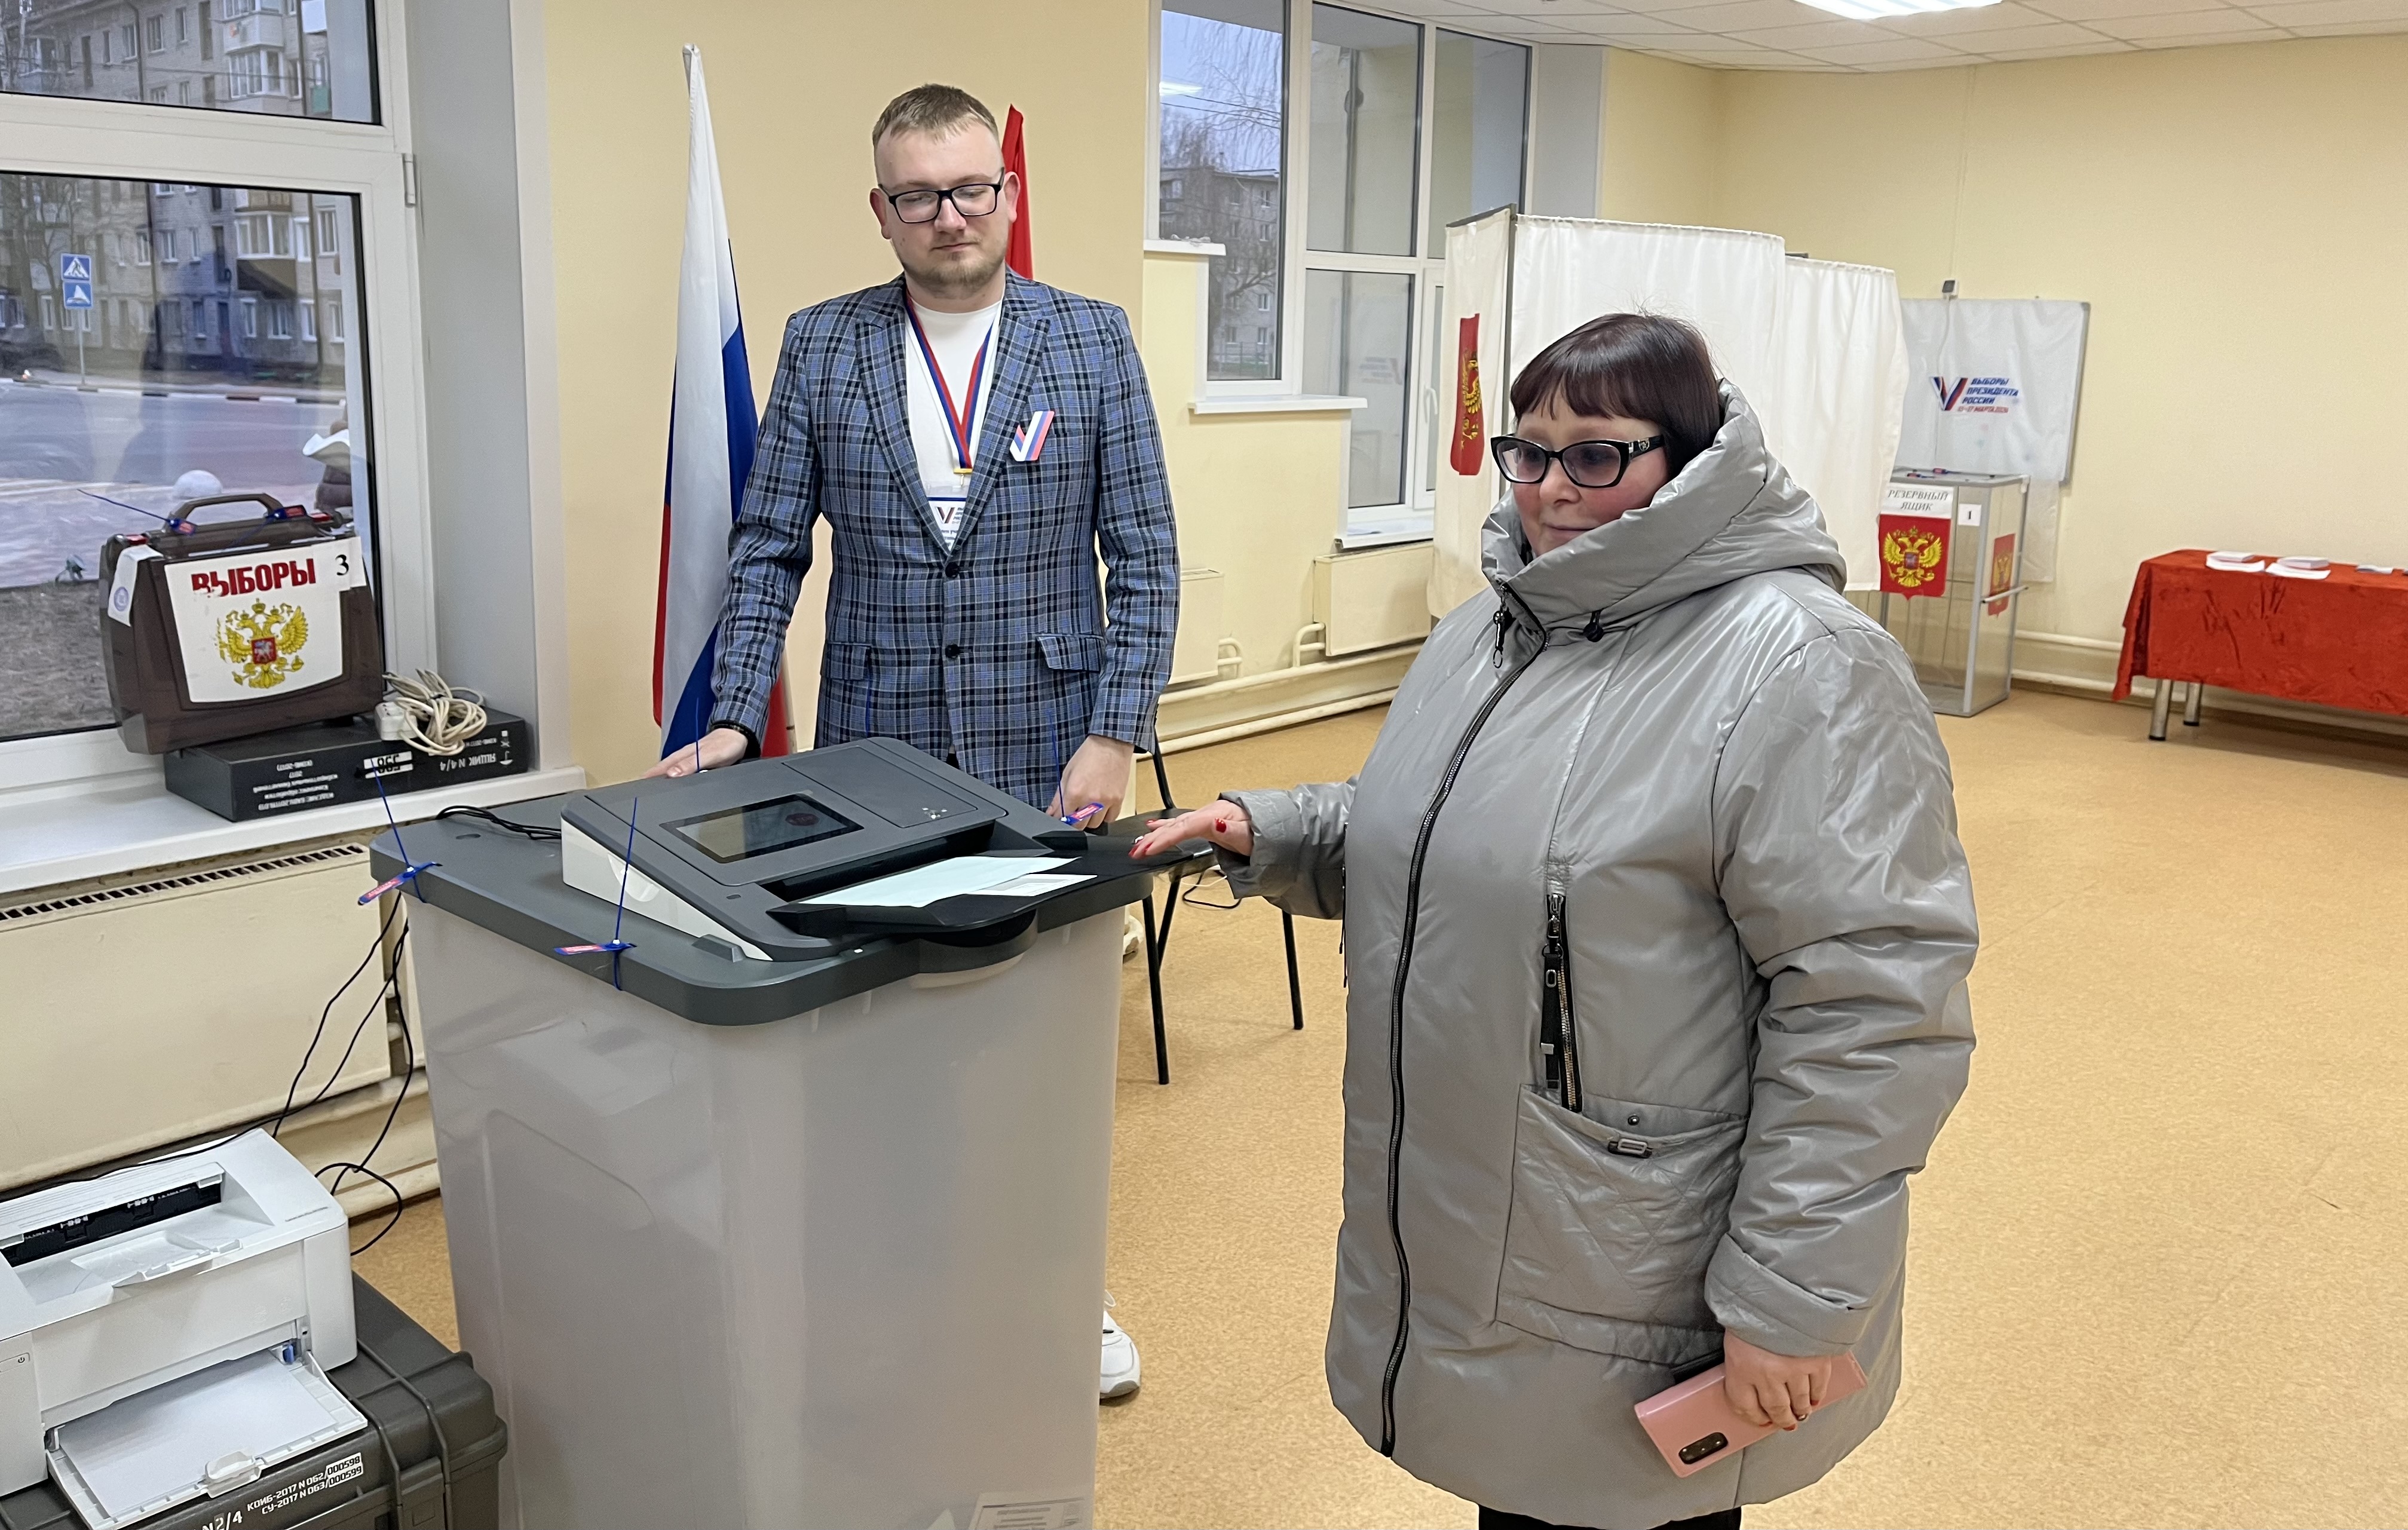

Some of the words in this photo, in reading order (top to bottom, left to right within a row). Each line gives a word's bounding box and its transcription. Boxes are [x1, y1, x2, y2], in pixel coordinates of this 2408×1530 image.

[1971, 378, 2009, 386] ВЫБОРЫ
[1966, 387, 2018, 397] ПРЕЗИДЕНТА
[1888, 489, 1949, 501] РЕЗЕРВНЫЙ
[1901, 501, 1934, 511] ЯЩИК
[335, 554, 350, 575] 3
[191, 558, 316, 597] ВЫБОРЫ
[458, 758, 465, 768] N
[468, 753, 496, 766] ЯЩИК
[247, 1483, 297, 1511] КОИБ-2017
[298, 1480, 306, 1489] N
[262, 1492, 298, 1514] СУ-2017
[299, 1489, 307, 1498] N
